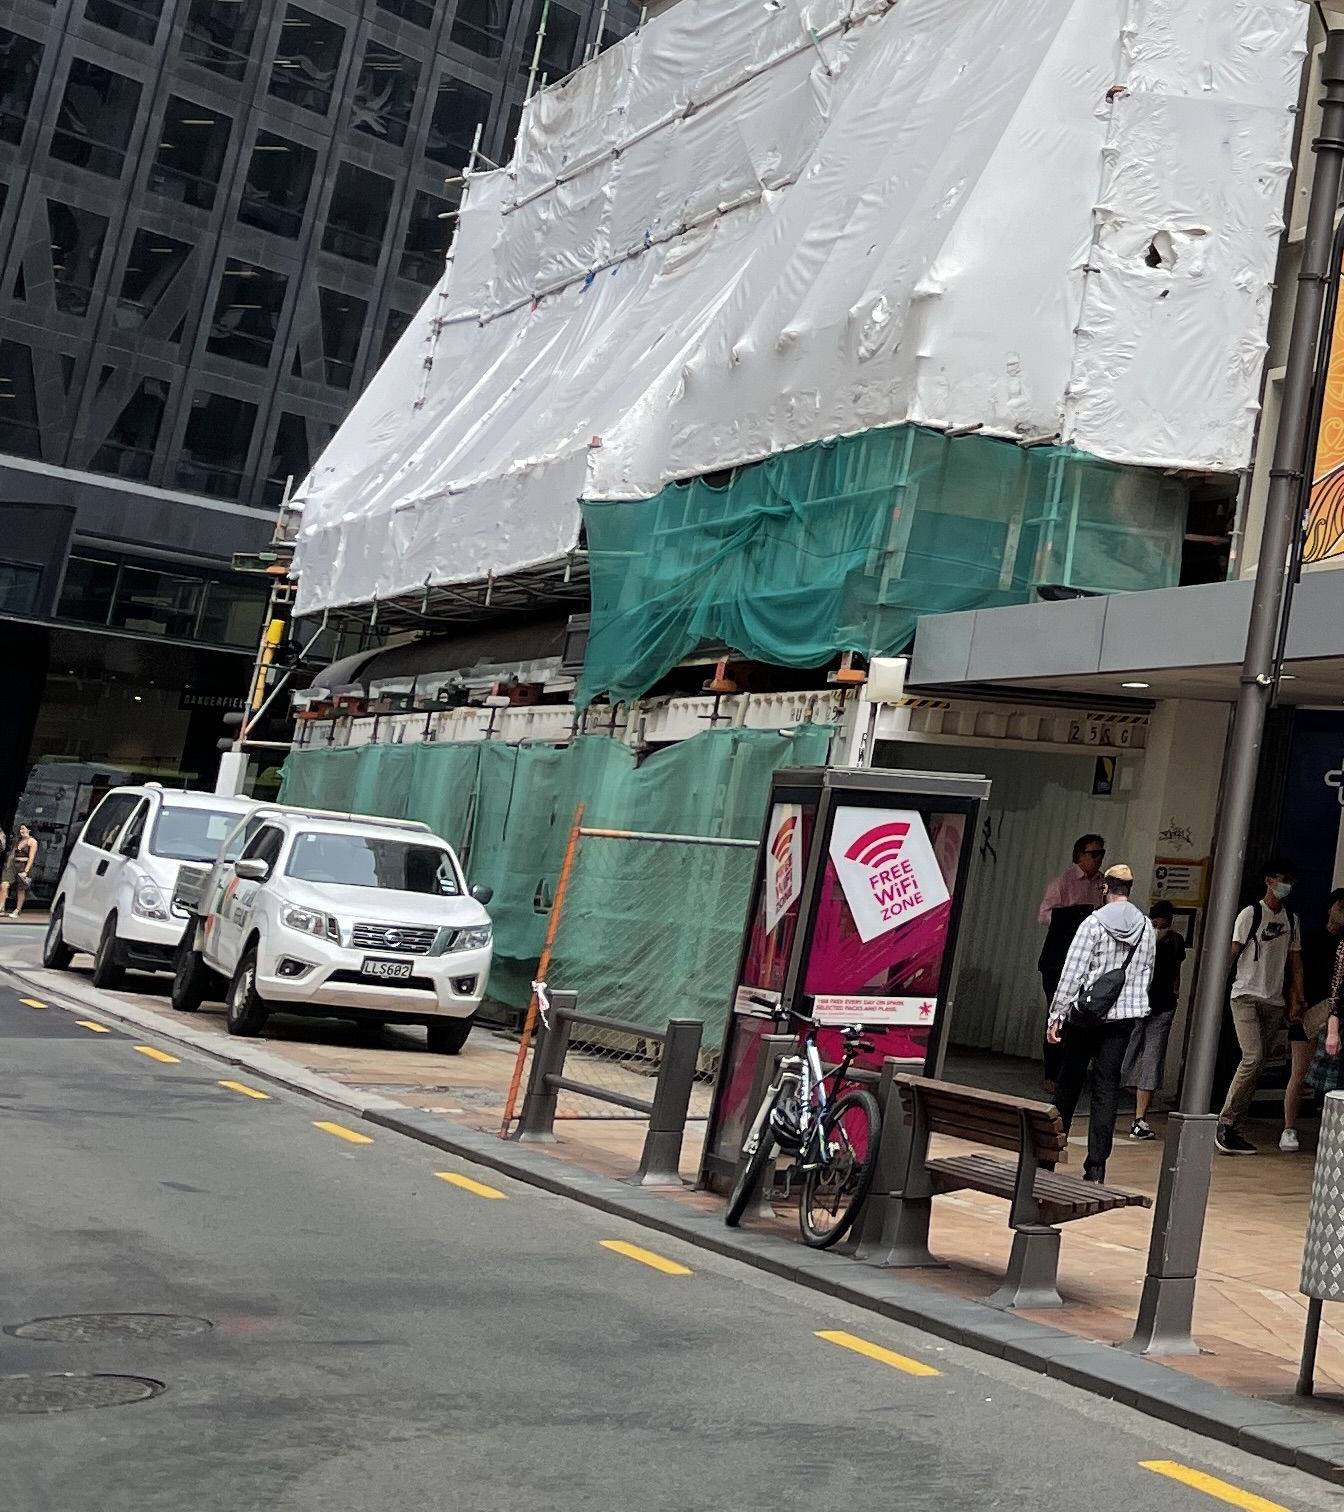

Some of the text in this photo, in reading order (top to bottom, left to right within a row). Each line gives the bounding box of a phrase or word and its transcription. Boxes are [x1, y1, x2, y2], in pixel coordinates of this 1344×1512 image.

[869, 859, 913, 890] FREE
[873, 875, 919, 907] WiFi
[879, 892, 924, 922] ZONE
